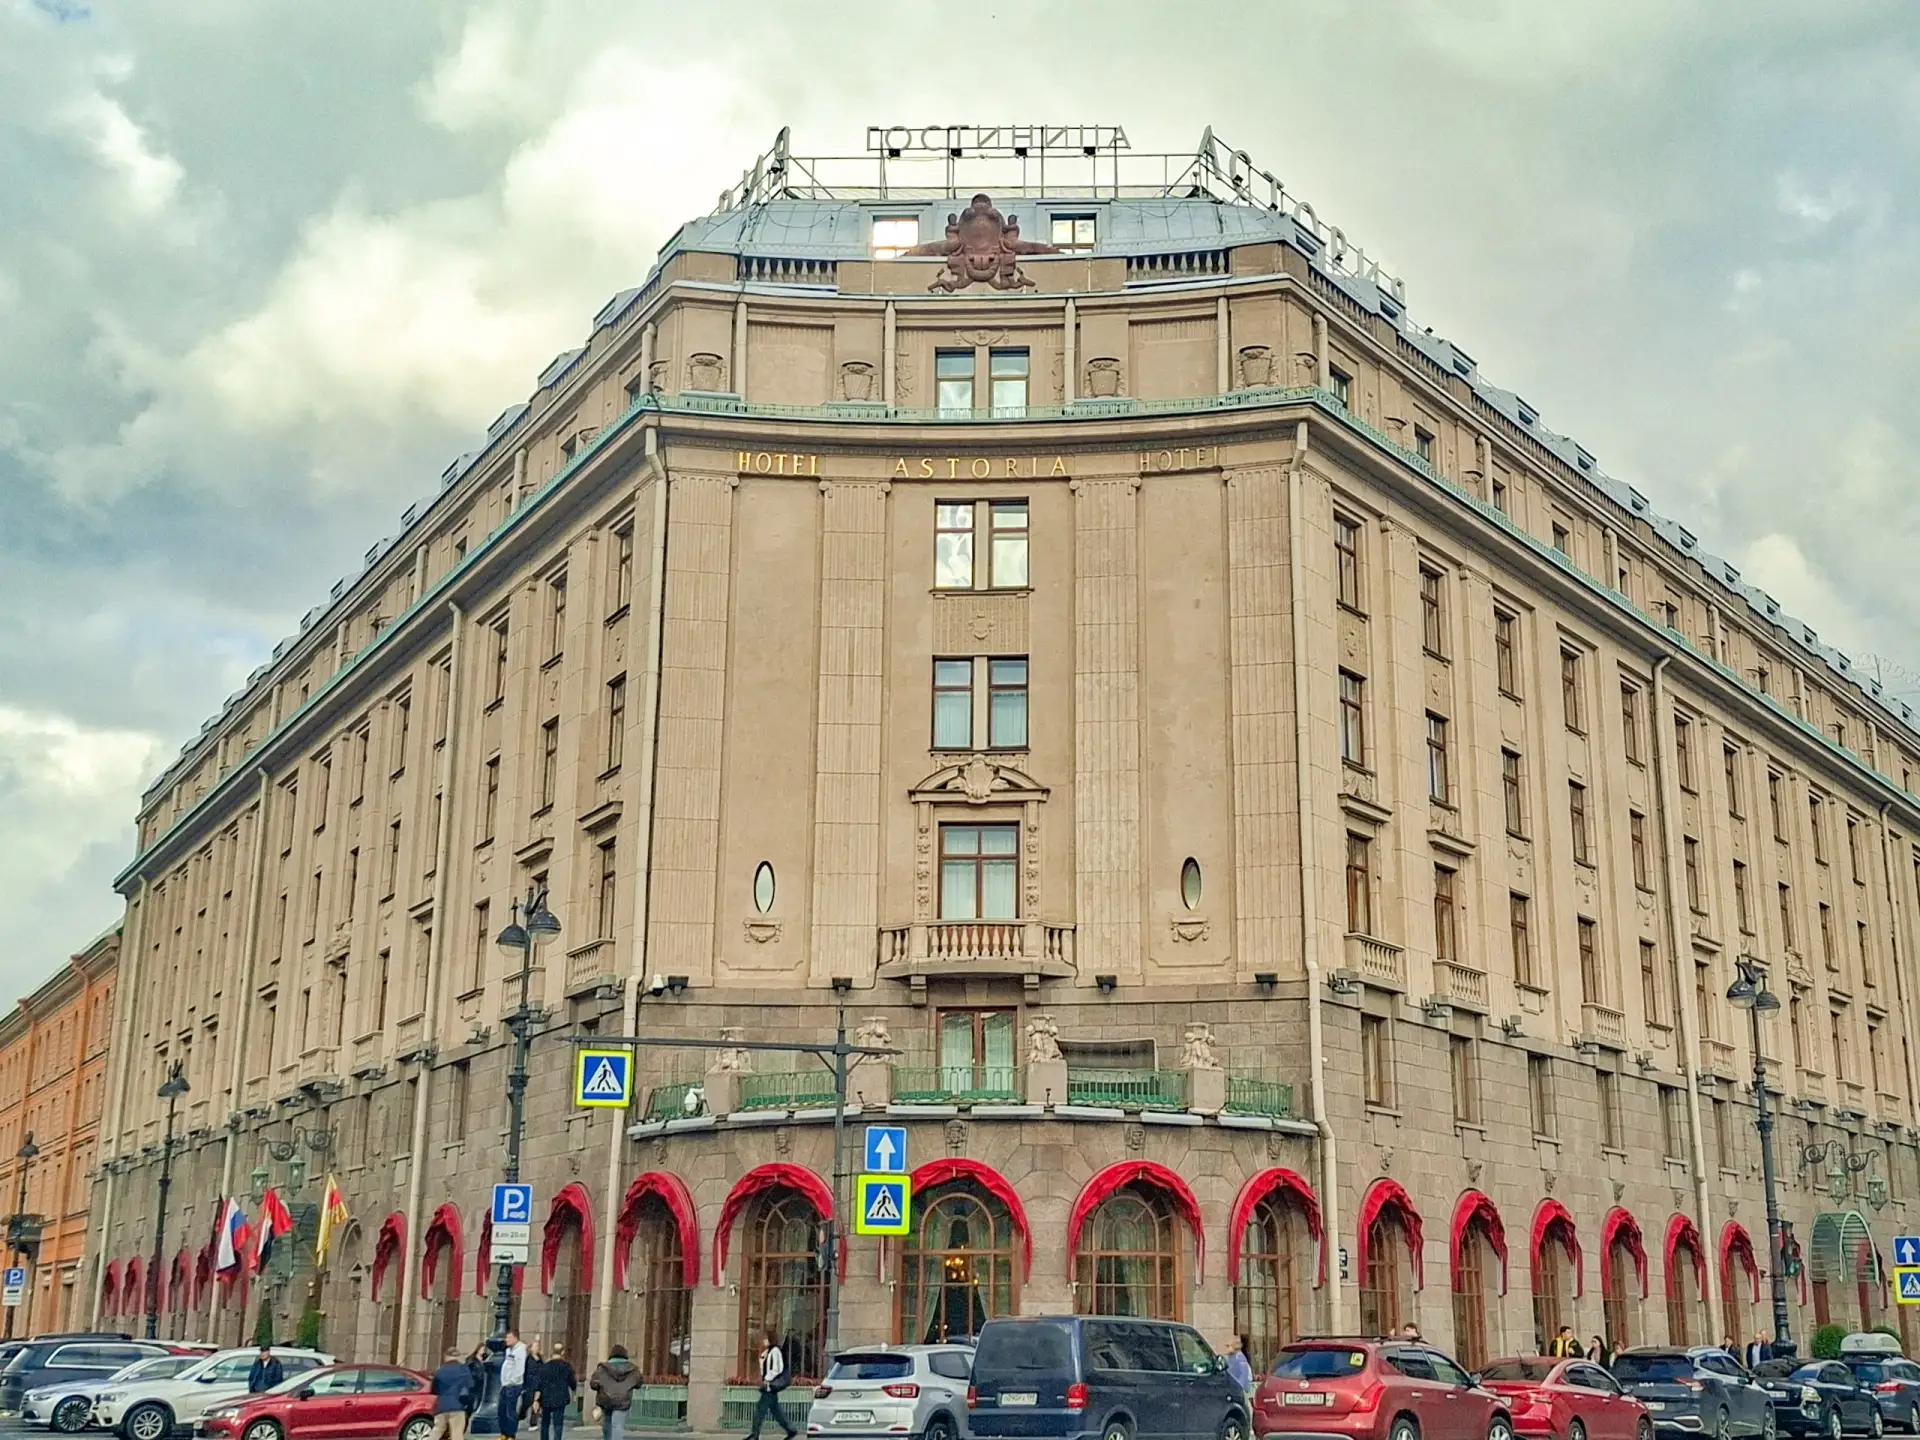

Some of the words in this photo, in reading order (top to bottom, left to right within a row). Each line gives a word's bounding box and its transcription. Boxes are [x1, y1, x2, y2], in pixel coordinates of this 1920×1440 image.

[867, 125, 1132, 152] ГОСТИНИЦА
[738, 451, 822, 476] HOTEL
[894, 455, 1068, 480] ASTORIA
[1140, 445, 1221, 472] HOTEL
